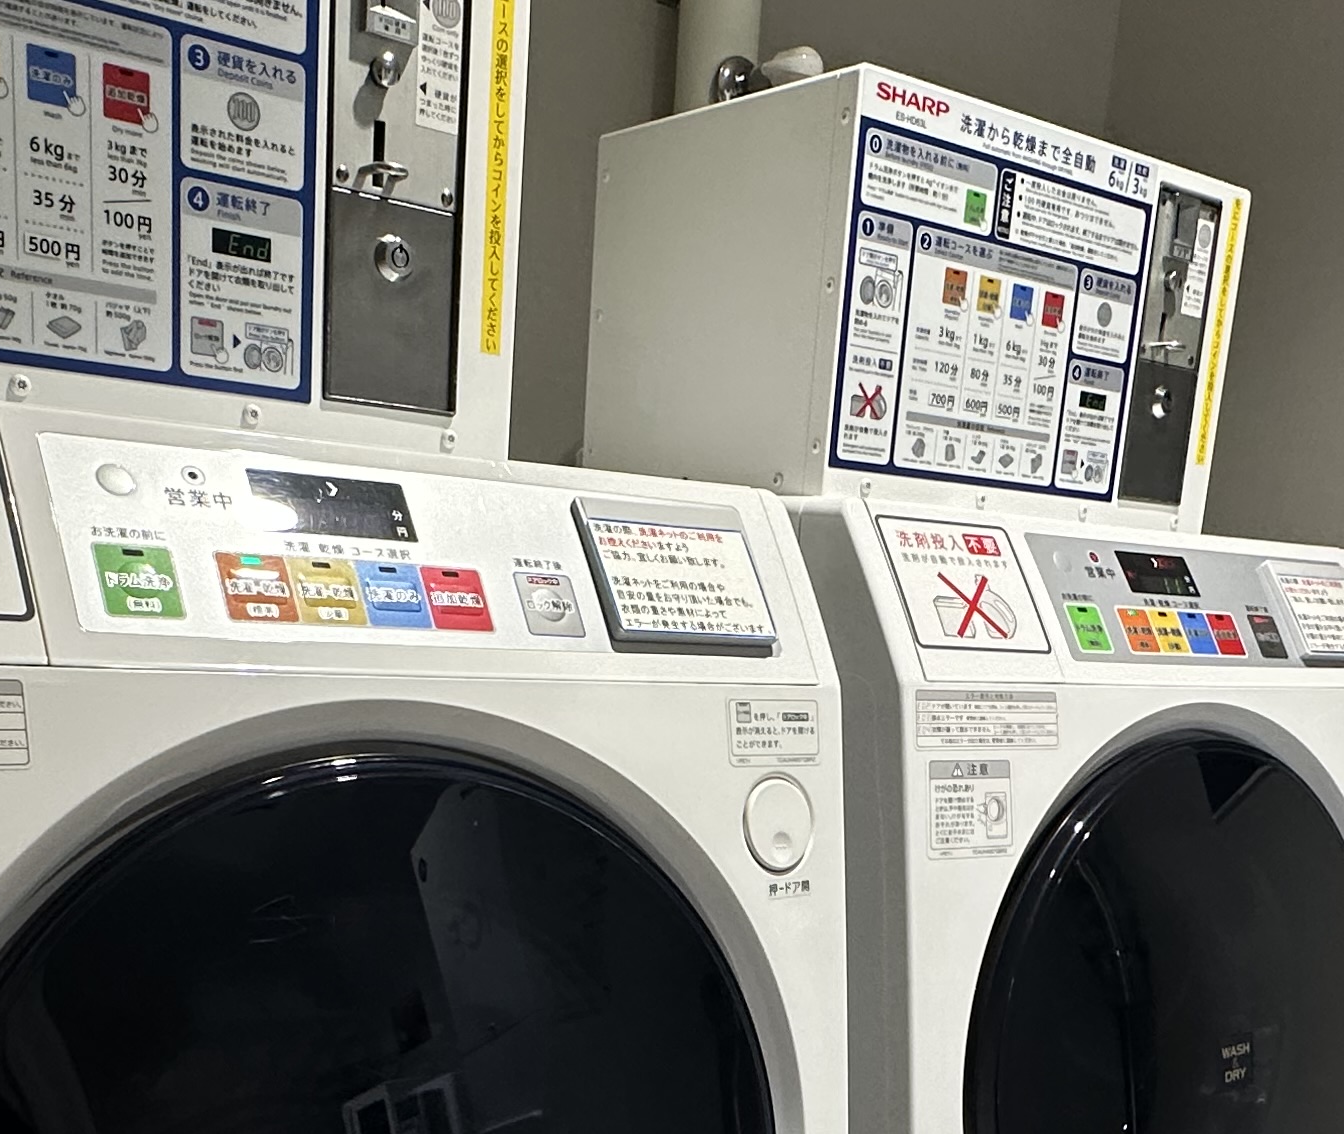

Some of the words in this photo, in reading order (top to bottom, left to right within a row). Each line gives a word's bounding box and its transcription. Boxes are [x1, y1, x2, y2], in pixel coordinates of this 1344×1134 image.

[194, 49, 205, 66] 3
[217, 51, 297, 84] 硬貨を入れる
[876, 81, 950, 117] SHARP
[29, 136, 41, 152] 6
[44, 137, 65, 161] kg
[115, 141, 127, 155] kg
[130, 145, 148, 158] まで
[960, 113, 1096, 174] 洗濯から乾燥まで全自動
[108, 165, 147, 188] 30分
[486, 0, 509, 352] ースの選択をしてからコインを投入してください
[1108, 171, 1124, 191] 6kg
[1132, 178, 1147, 198] 3kg
[32, 189, 76, 214] 35分
[193, 191, 204, 208] 4
[216, 192, 271, 216] 運転終了
[104, 209, 152, 234] 100円
[29, 237, 81, 261] 500円
[228, 234, 269, 260] End
[10, 270, 53, 285] Reference
[934, 361, 958, 376] 120分
[970, 368, 989, 382] 80分
[1003, 374, 1022, 388] 35分
[1033, 383, 1055, 400] 100円
[931, 393, 955, 408] 700円
[965, 399, 988, 413] 600円
[997, 404, 1020, 419] 500円
[164, 487, 233, 511] 営業中
[392, 510, 404, 522] 分
[91, 526, 167, 541] お洗濯の前に
[397, 526, 409, 538] 円
[895, 530, 964, 551] 洗剤投入
[965, 536, 1000, 555] 不要
[352, 547, 412, 560] コース選択
[901, 552, 1008, 569] 洗剤が自動で投入されます
[513, 557, 563, 571] 運転終了後
[1084, 566, 1116, 580] 営業中
[612, 576, 725, 592] 洗濯ネットをご利用の場合や
[526, 597, 573, 613] ロック解除
[1221, 1042, 1250, 1059] WASH
[1224, 1067, 1247, 1083] DRY
